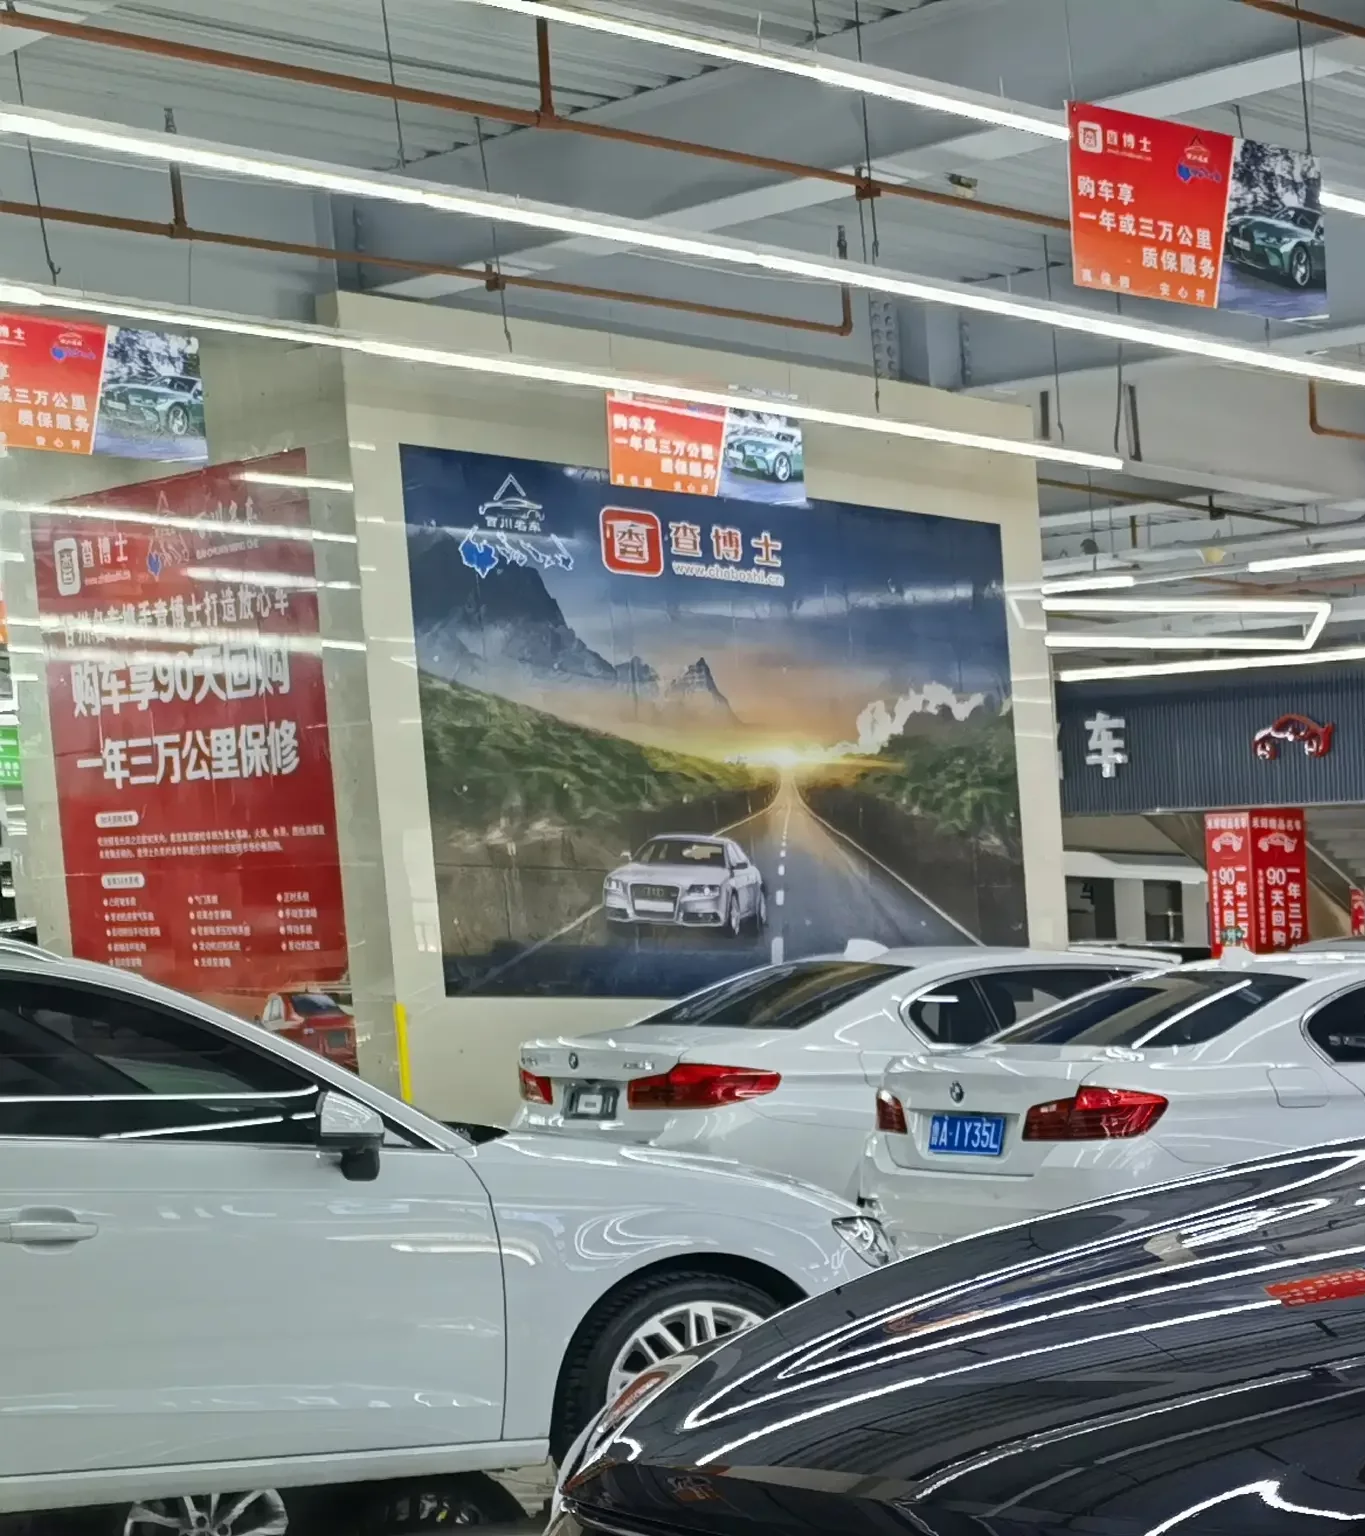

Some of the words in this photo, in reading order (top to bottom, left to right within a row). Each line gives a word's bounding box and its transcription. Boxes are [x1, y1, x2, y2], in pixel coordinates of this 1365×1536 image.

[1077, 175, 1135, 206] 购车享
[1078, 208, 1213, 251] 一年或三万公里
[1142, 247, 1215, 280] 质保服务
[669, 520, 783, 568] 查博士
[77, 719, 300, 790] 一年三万公里保修
[1085, 711, 1128, 778] 车
